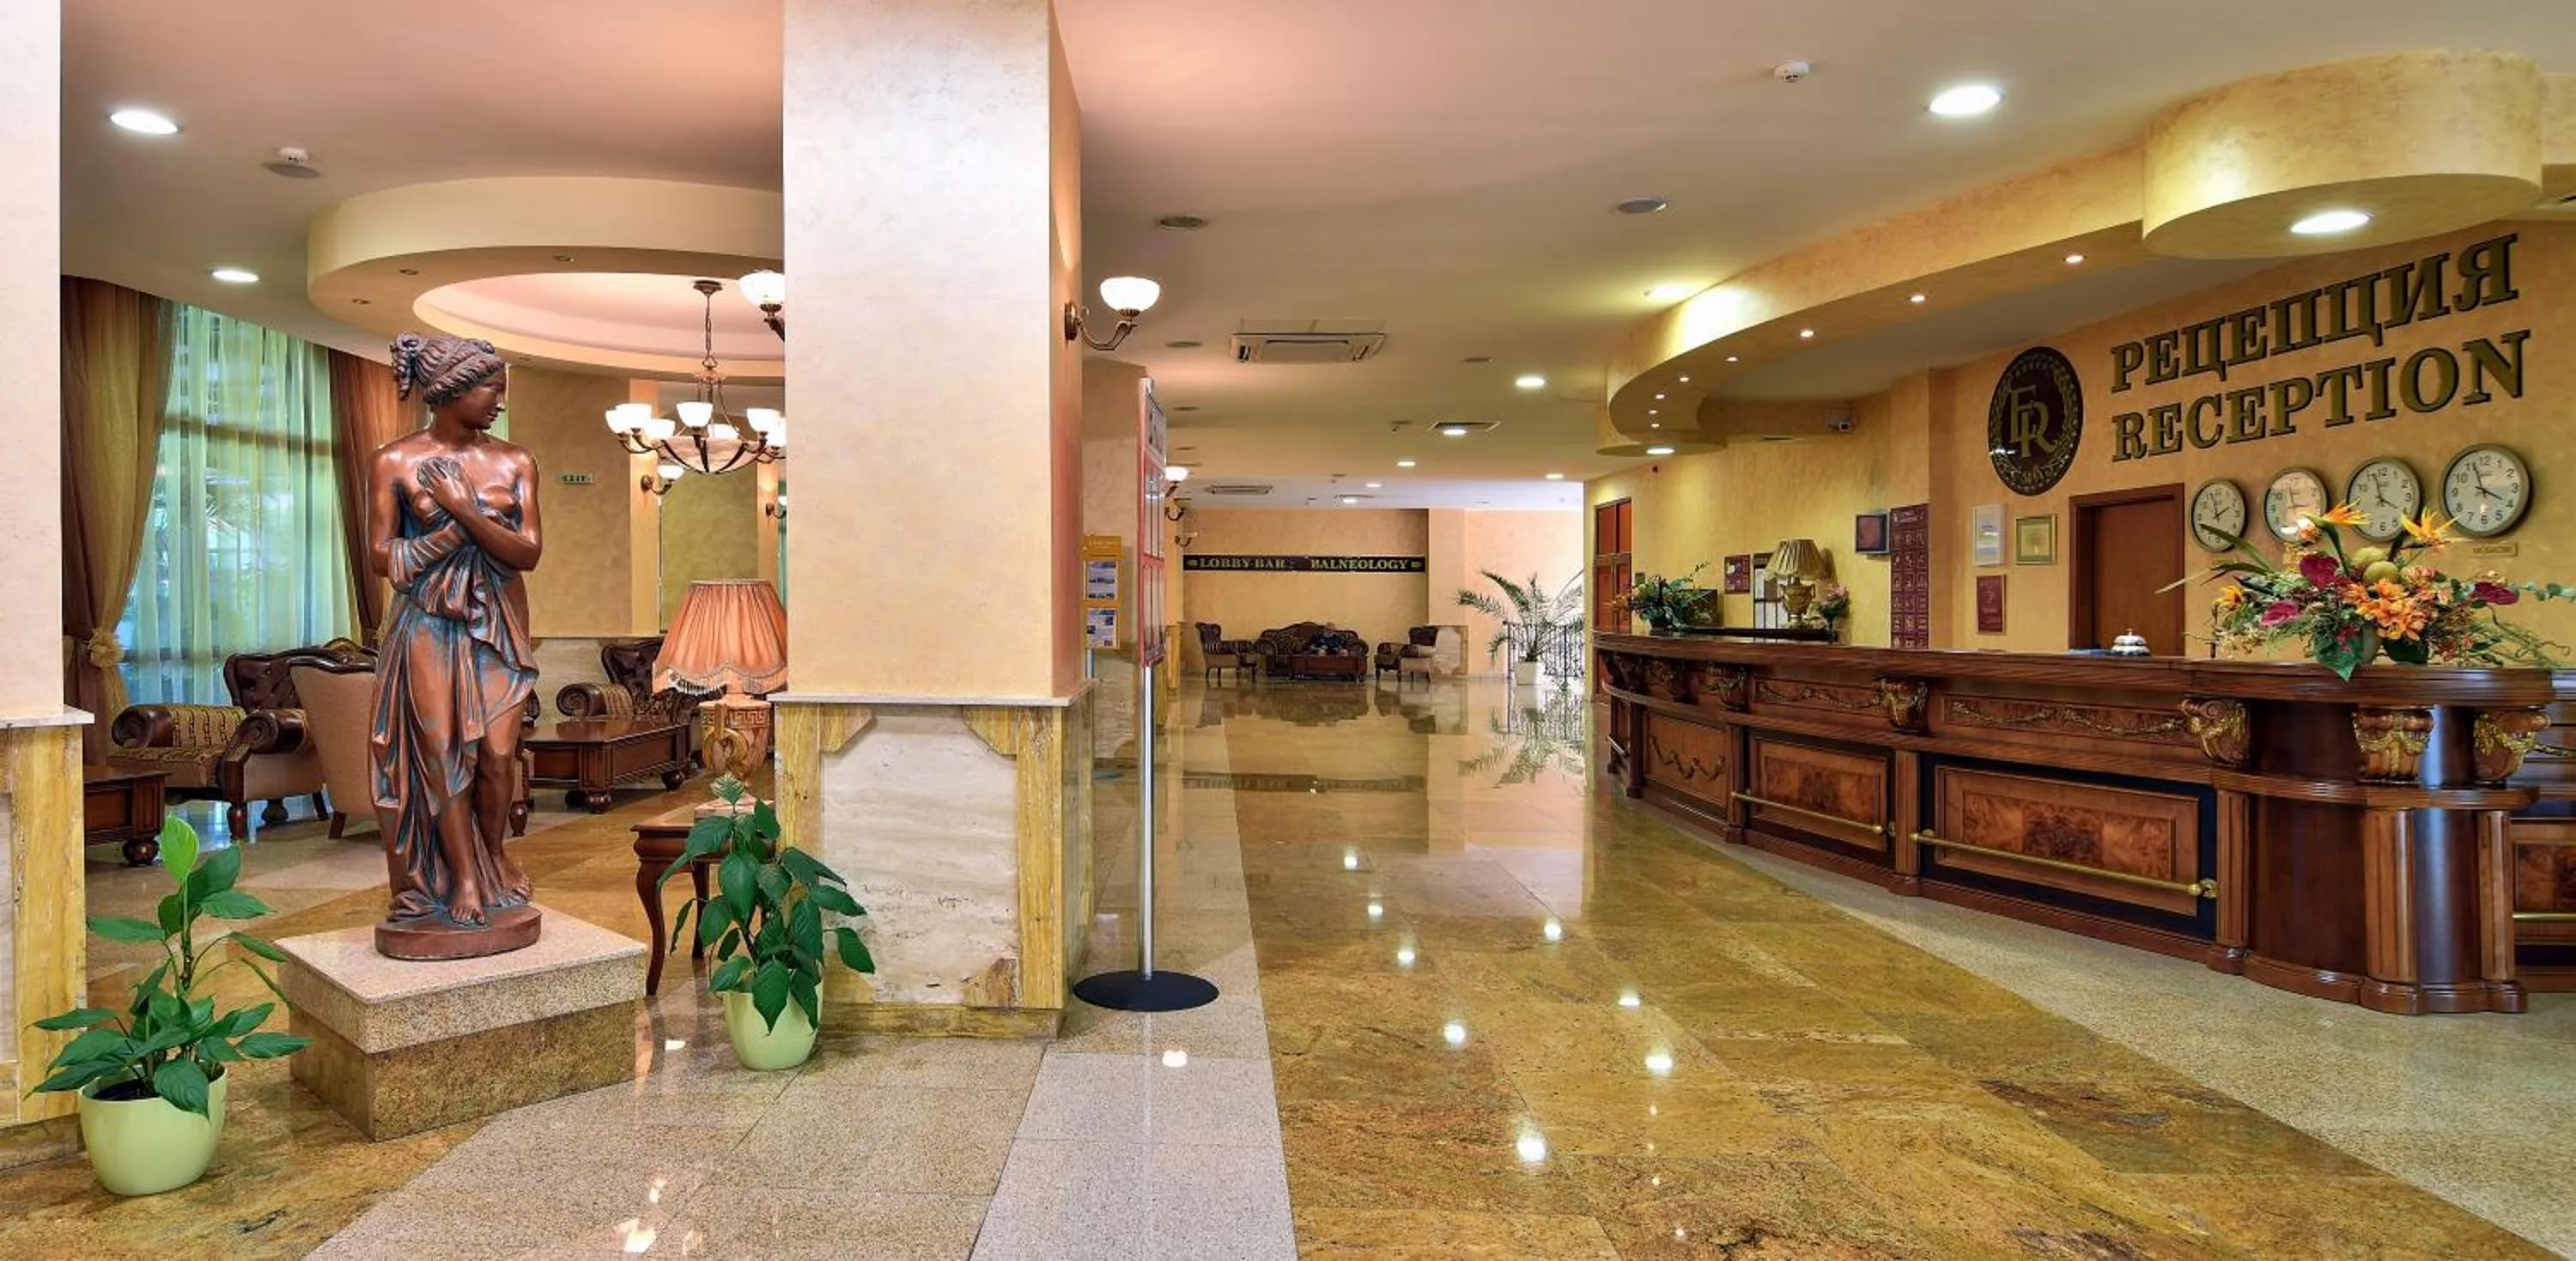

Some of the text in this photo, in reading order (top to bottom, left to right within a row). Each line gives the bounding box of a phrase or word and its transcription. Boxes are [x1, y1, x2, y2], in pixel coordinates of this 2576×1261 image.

[2111, 233, 2519, 393] РЕЦЕПЦИЯ
[2111, 329, 2531, 462] RECEPTION
[2479, 455, 2491, 466] 12
[2457, 472, 2468, 483] 10
[2506, 468, 2514, 478] 2
[2512, 482, 2519, 494] 3
[2495, 509, 2503, 521] 5
[1200, 557, 1408, 570] LOBBY-BAR BALNEOLOGY
